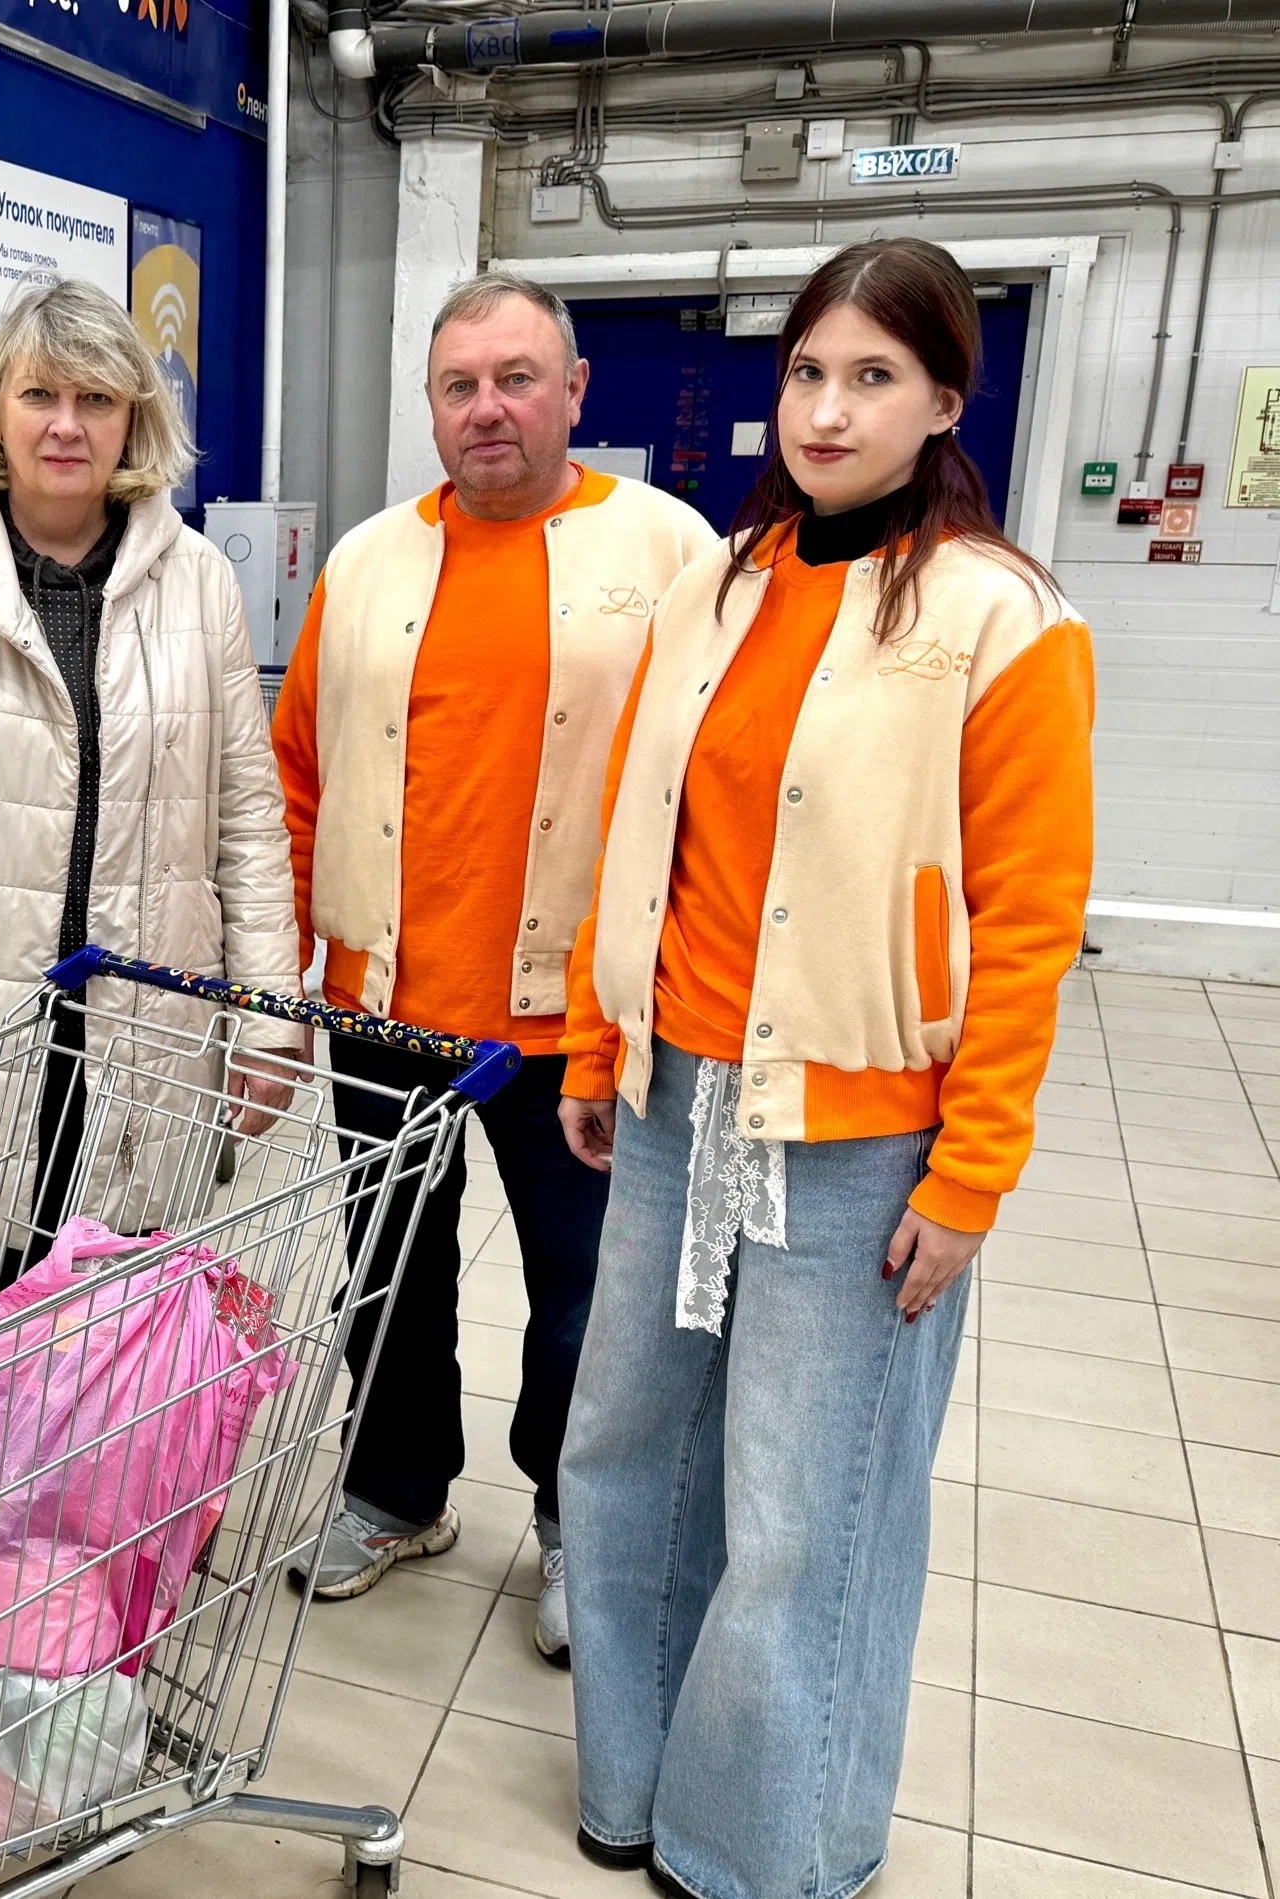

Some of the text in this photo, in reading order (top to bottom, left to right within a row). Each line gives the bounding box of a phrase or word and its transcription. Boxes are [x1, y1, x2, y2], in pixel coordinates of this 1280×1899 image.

[246, 96, 268, 123] лент
[862, 150, 948, 177] ВЫХОД
[46, 209, 115, 246] покупателя
[10, 248, 33, 263] готовы
[34, 254, 58, 268] помочь
